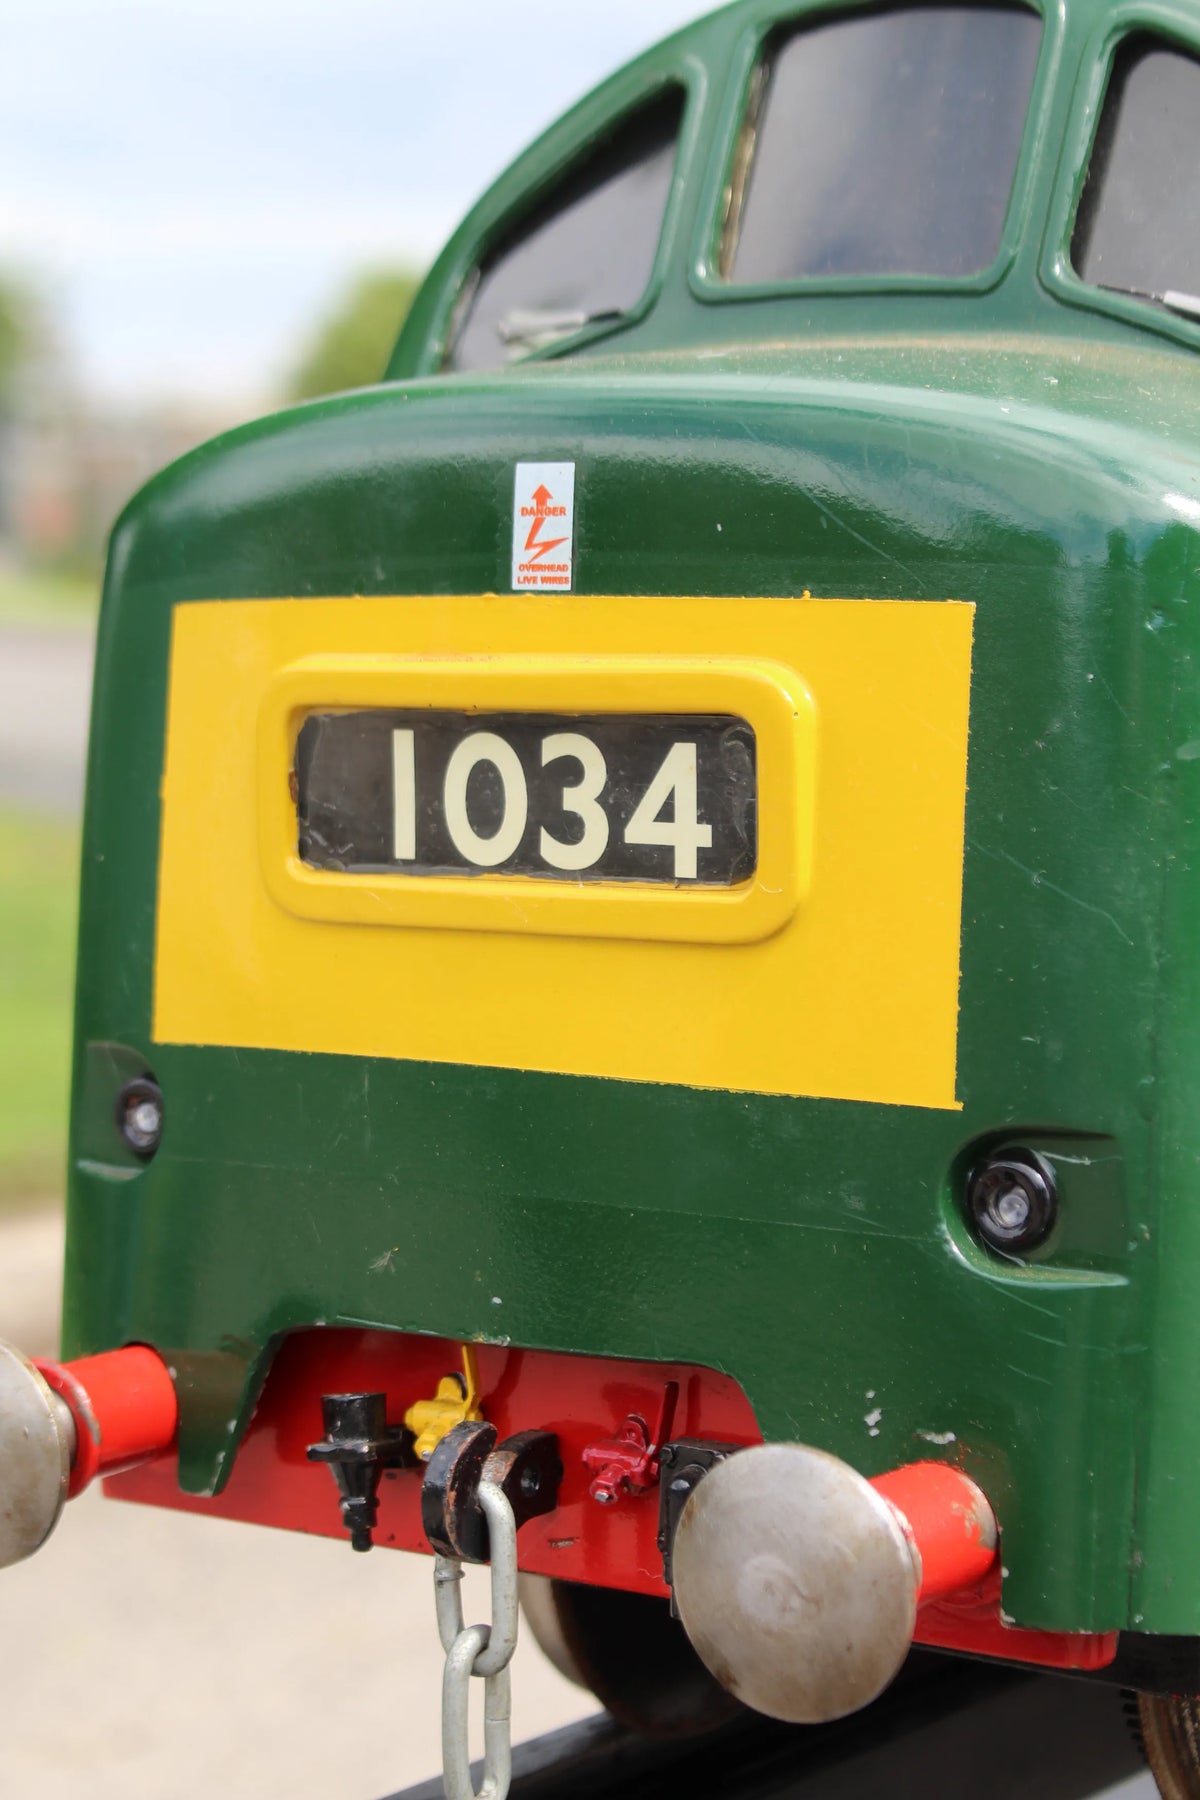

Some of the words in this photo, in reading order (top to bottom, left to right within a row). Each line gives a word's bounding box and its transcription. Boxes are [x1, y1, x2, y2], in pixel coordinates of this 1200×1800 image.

[520, 506, 567, 517] DANGER
[518, 563, 569, 572] OVERHEAD
[517, 575, 538, 585] LIVE
[540, 576, 570, 585] WIRES
[392, 728, 713, 879] 1034
